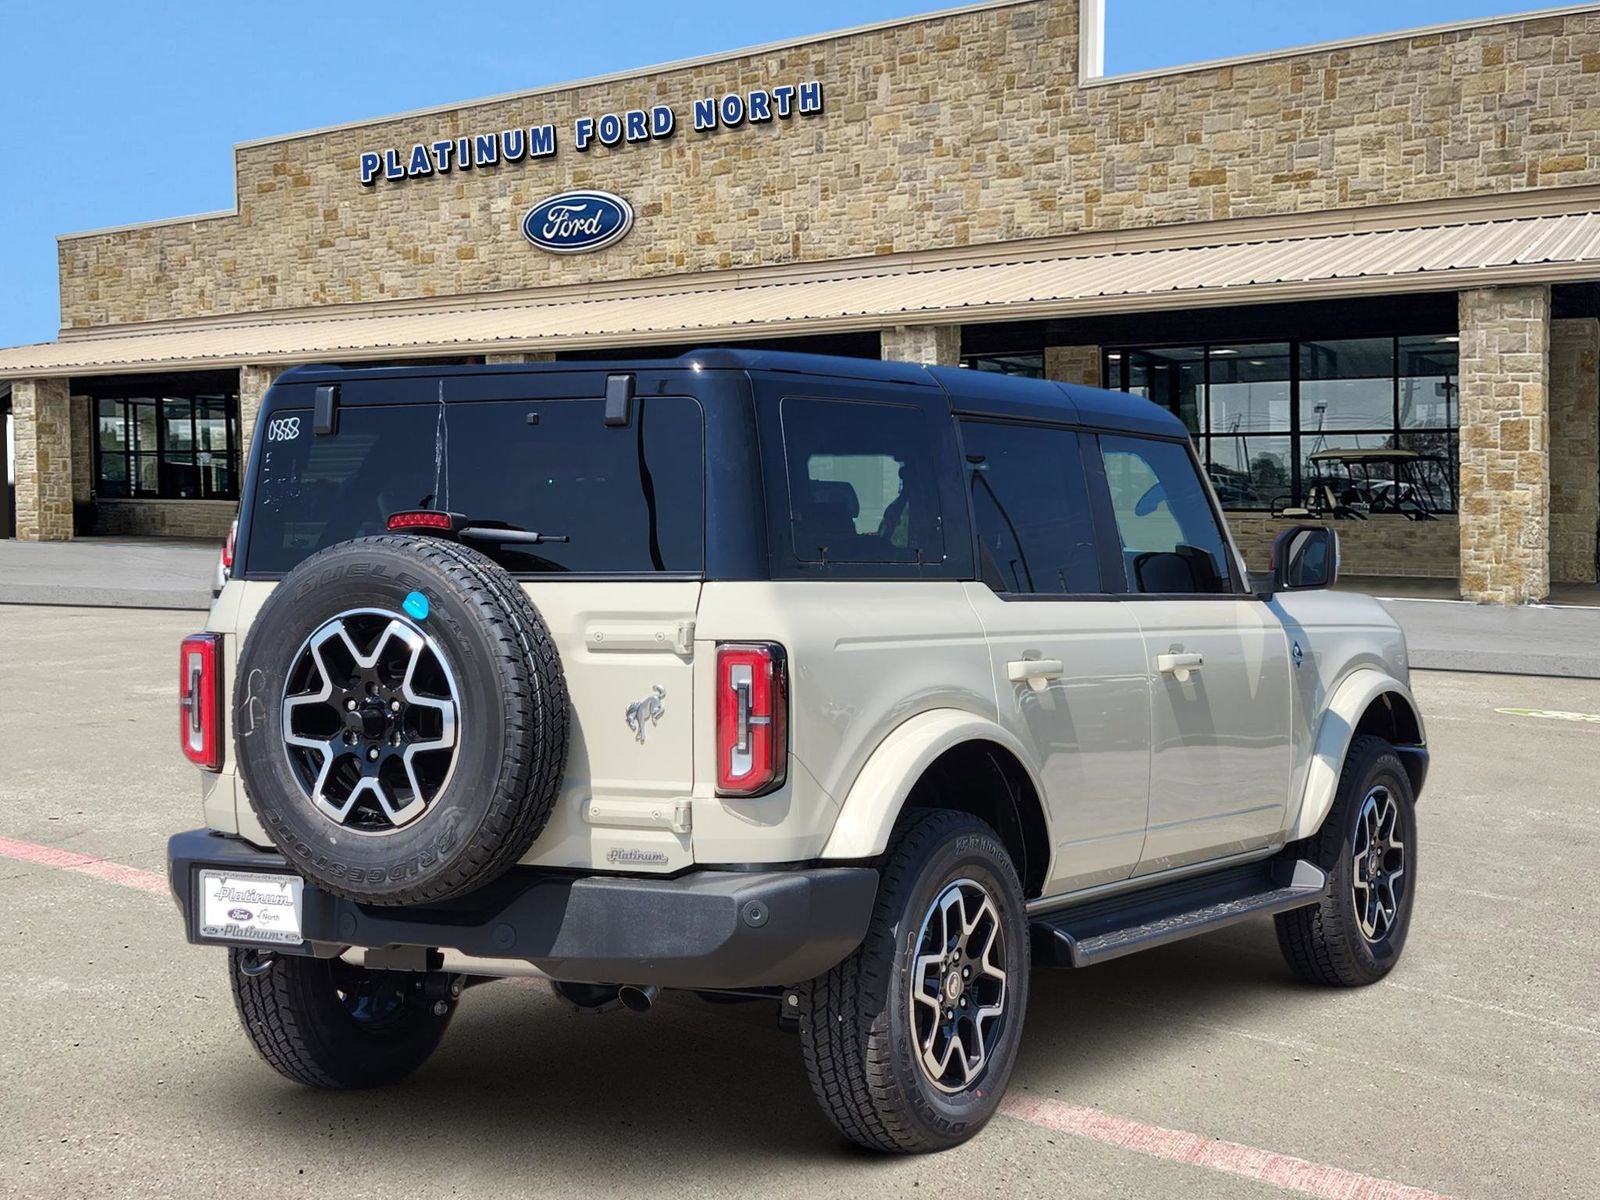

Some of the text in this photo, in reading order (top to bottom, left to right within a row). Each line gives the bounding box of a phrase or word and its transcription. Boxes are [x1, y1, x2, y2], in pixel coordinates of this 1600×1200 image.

[360, 81, 823, 185] PLATINUM FORD NORTH
[542, 204, 602, 240] Ford
[268, 416, 300, 441] 0888
[214, 886, 294, 906] Platinum
[223, 922, 281, 940] Platinum
